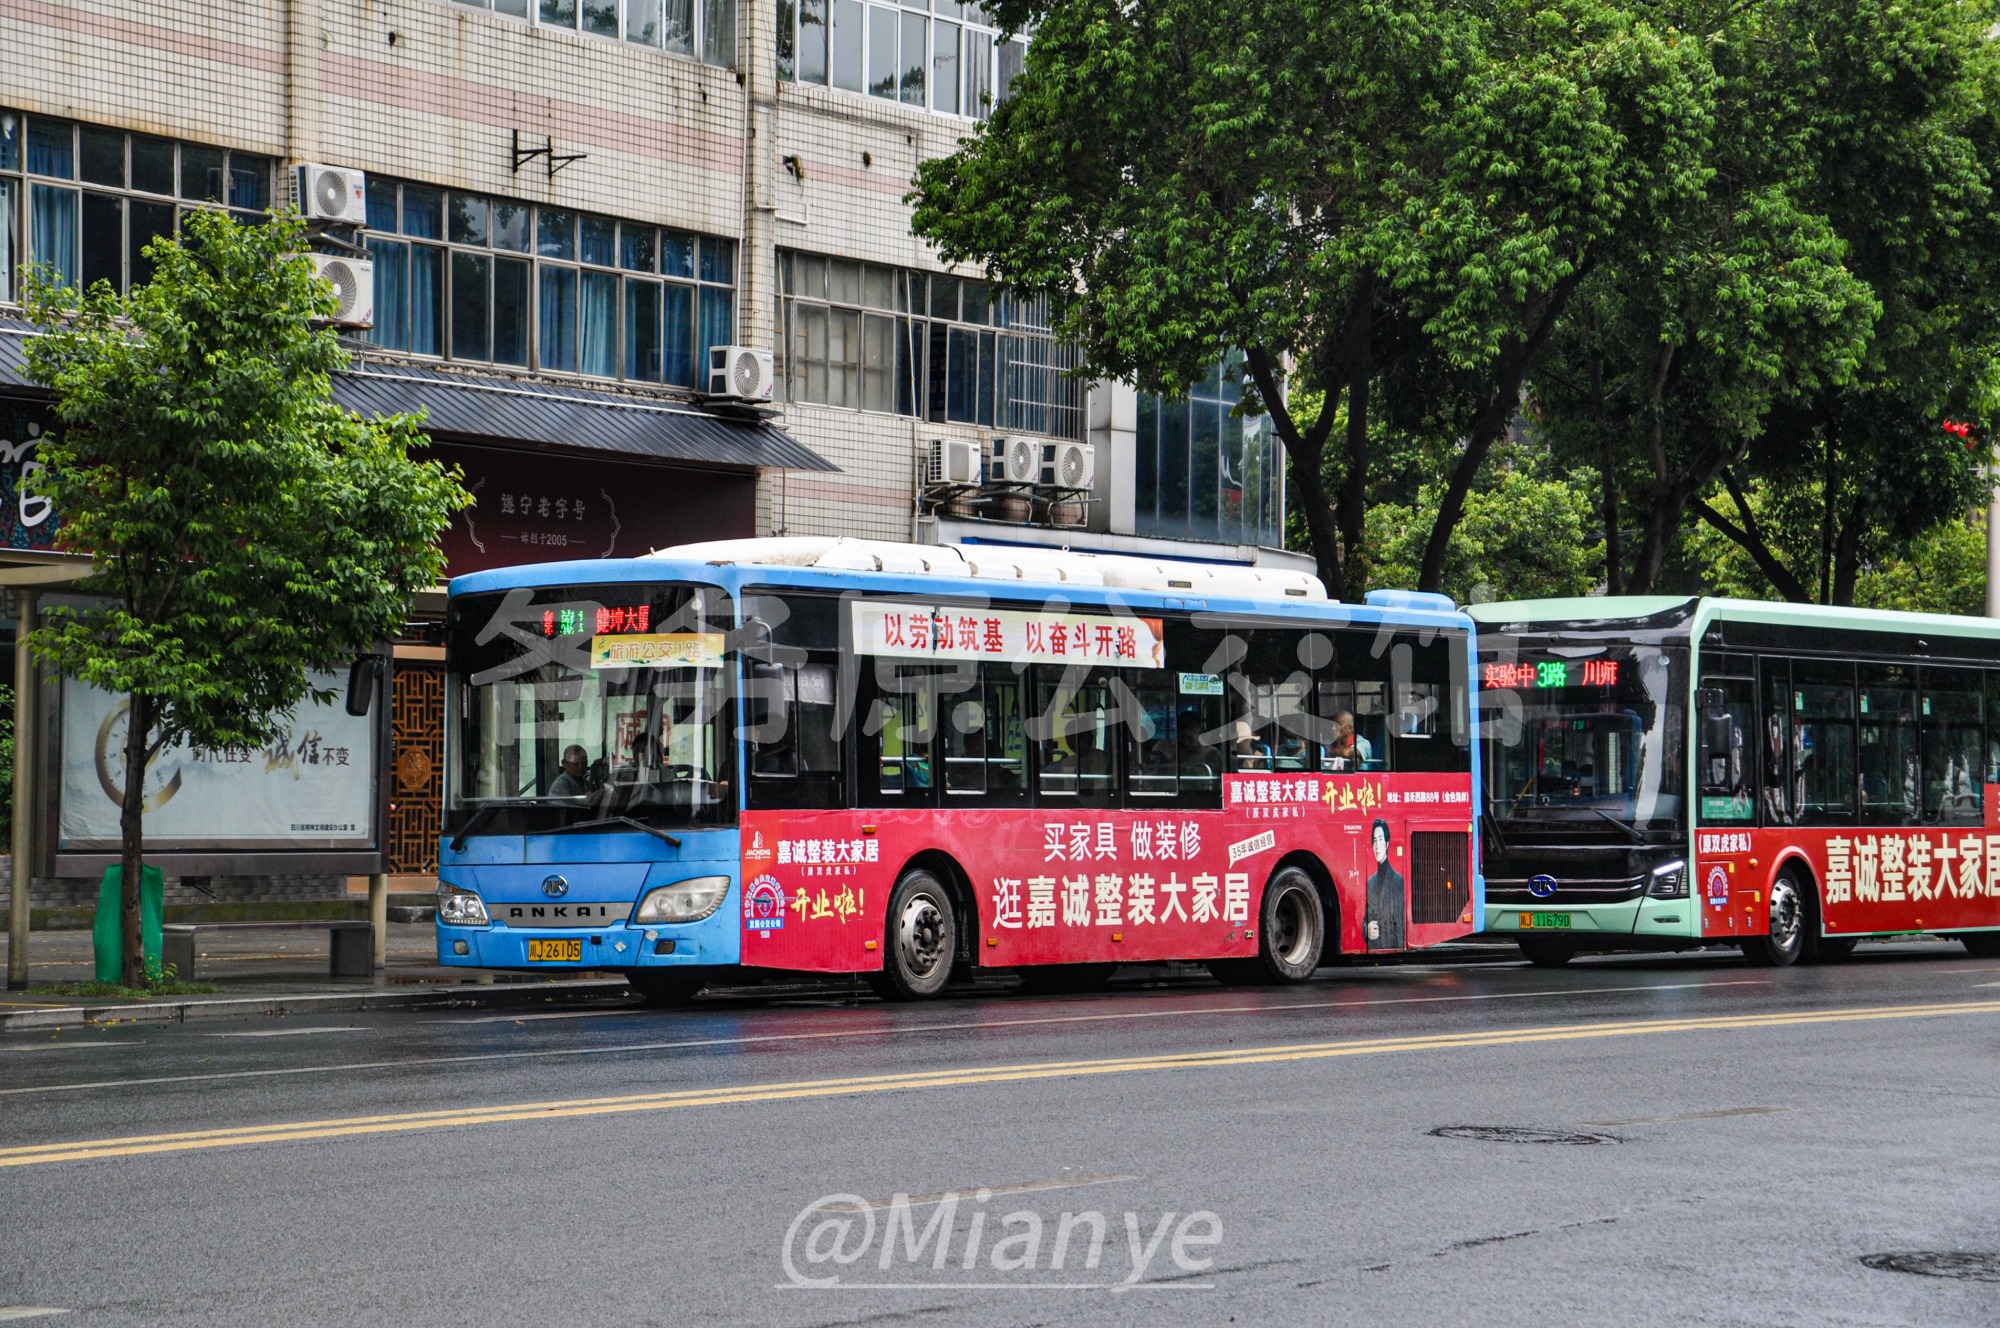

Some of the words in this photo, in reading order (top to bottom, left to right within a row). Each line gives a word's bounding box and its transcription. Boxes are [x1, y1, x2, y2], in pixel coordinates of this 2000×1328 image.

[501, 493, 586, 520] 遂宁老字号
[520, 532, 567, 546] 始创于2005
[884, 612, 1002, 653] 以劳动筑基
[1025, 620, 1137, 660] 以奋斗开路
[609, 641, 702, 660] 旅游公交1路
[1485, 663, 1535, 688] 实验中
[1537, 661, 1567, 688] 3路
[1582, 660, 1618, 686] 川师
[1230, 780, 1319, 804] 嘉诚整装大家居
[776, 838, 879, 864] 嘉诚整装大家居
[1044, 821, 1117, 863] 买家具
[1131, 820, 1201, 861] 做装修
[1231, 835, 1274, 860] 35年诚信经营
[510, 906, 606, 918] ANKAI
[992, 871, 1250, 930] 逛嘉诚整装大家居
